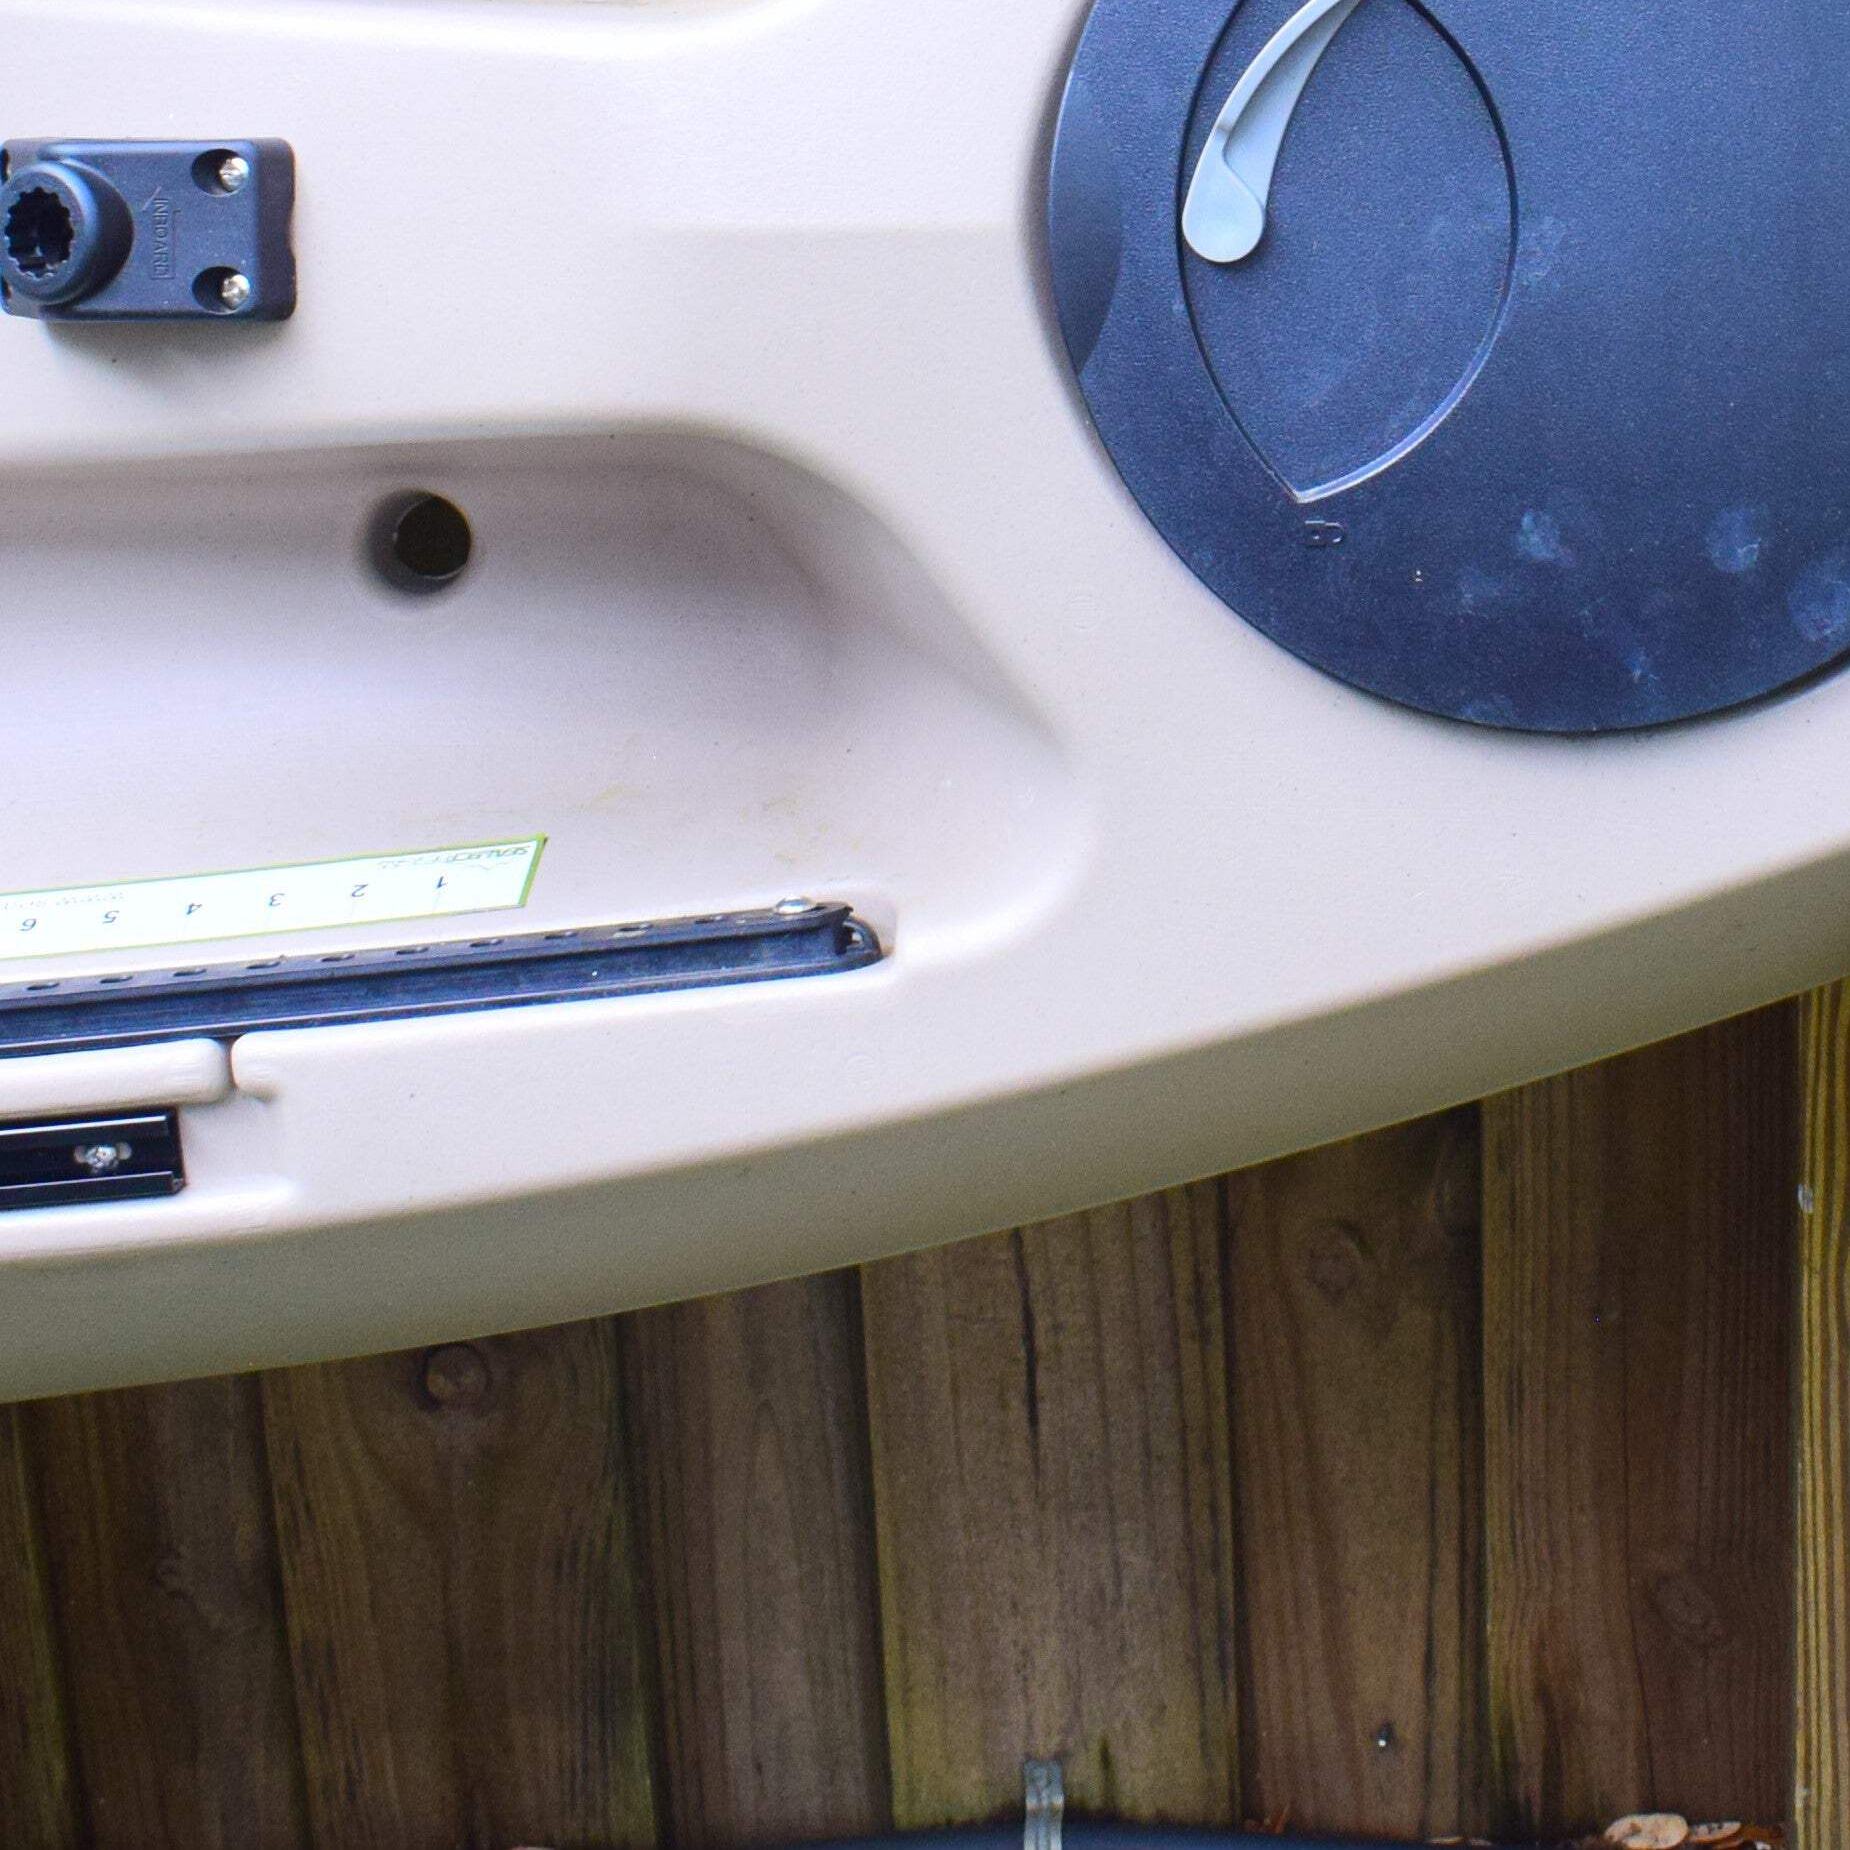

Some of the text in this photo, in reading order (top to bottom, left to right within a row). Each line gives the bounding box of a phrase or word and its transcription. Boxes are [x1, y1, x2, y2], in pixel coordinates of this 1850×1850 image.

[351, 883, 369, 898] 2
[269, 892, 286, 907] 3
[186, 902, 203, 916] 4
[103, 910, 120, 924] 5
[18, 918, 38, 933] 6
